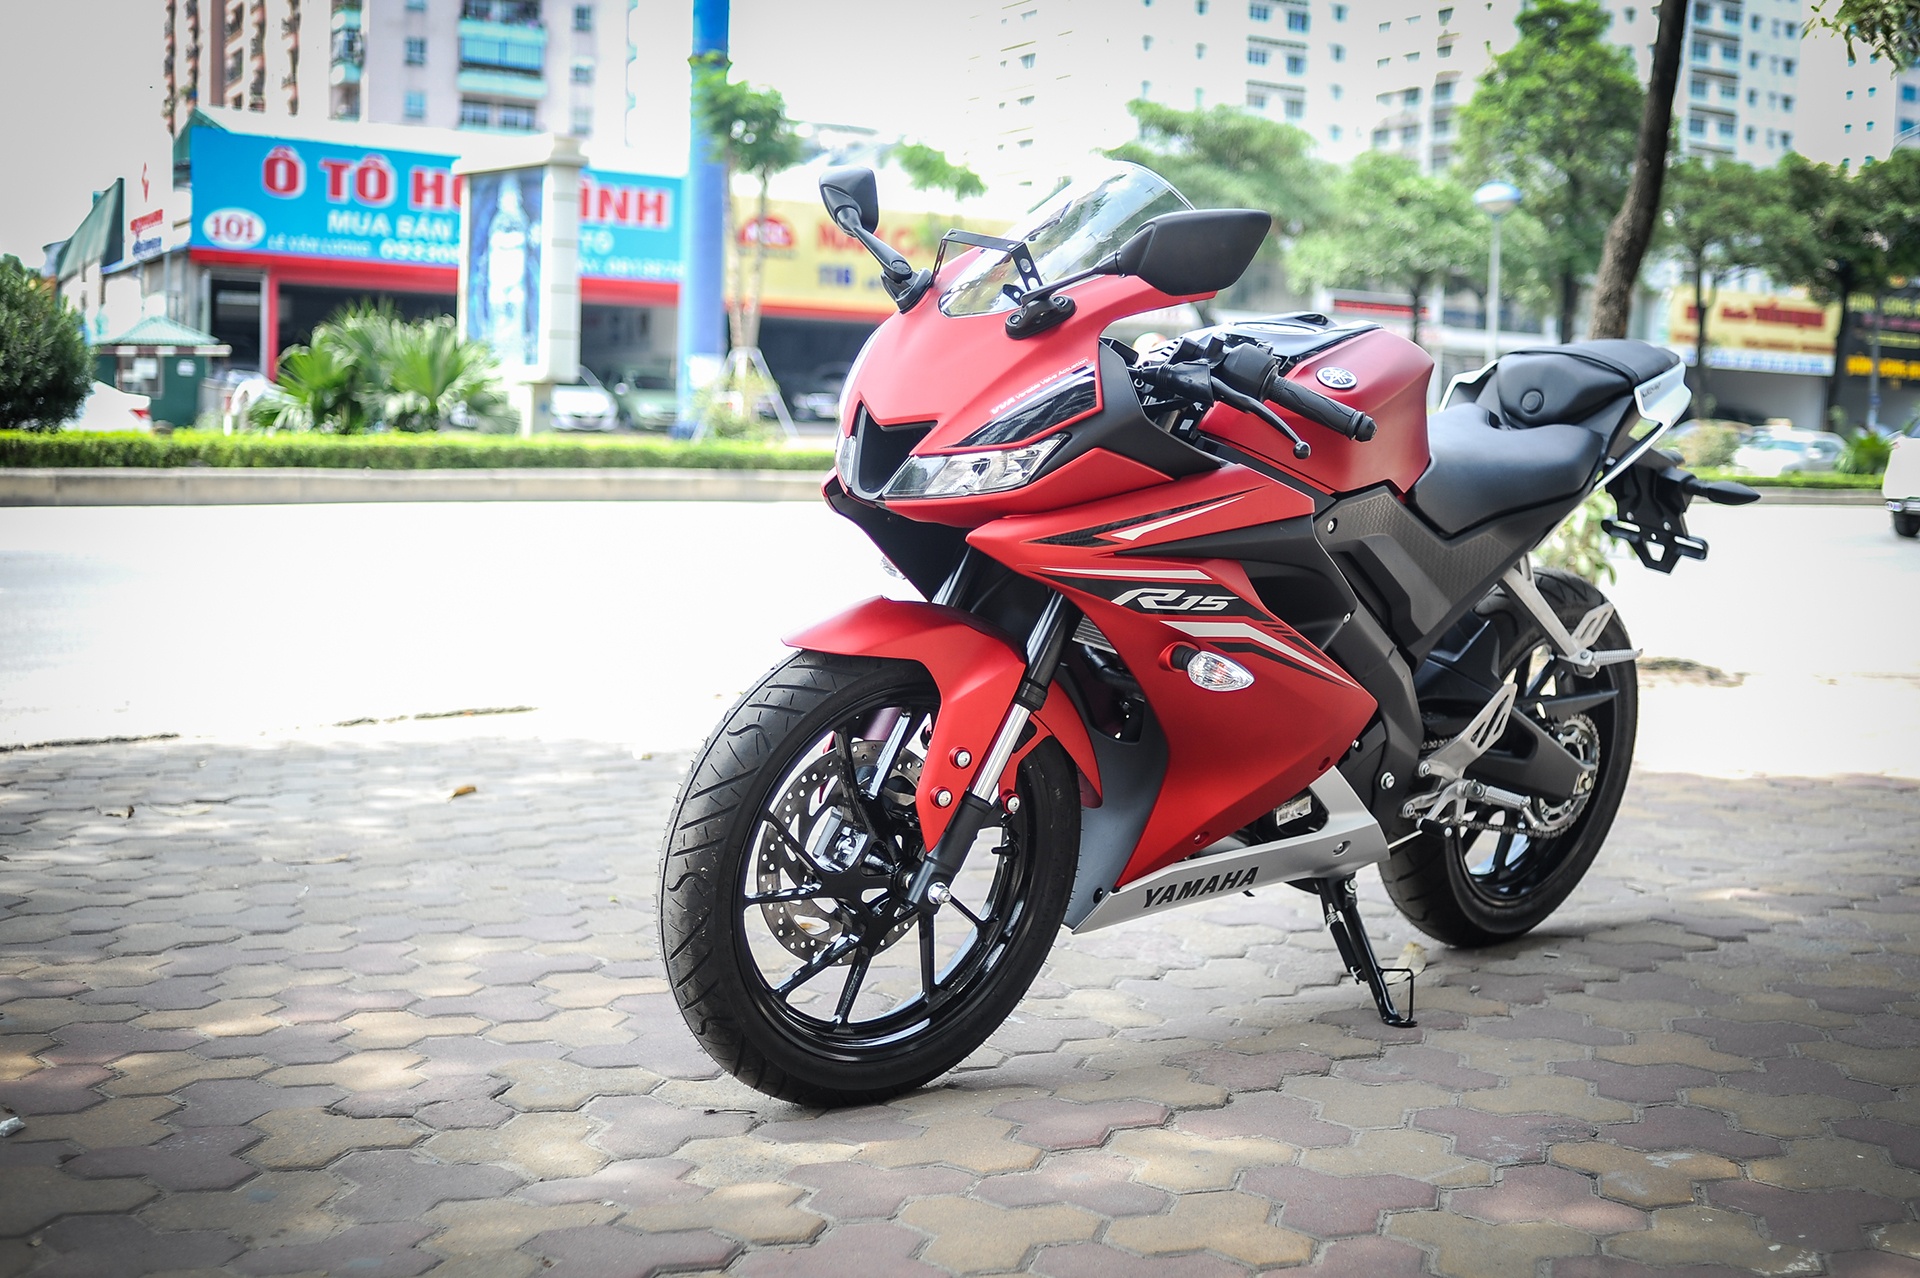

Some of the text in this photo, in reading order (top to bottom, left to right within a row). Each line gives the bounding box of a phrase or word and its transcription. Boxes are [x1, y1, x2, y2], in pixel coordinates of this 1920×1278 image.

[262, 145, 300, 196] Ô
[320, 154, 391, 202] TÔ
[210, 213, 257, 240] 101
[327, 210, 392, 237] MUA
[1015, 382, 1041, 399] Variable
[1040, 374, 1058, 385] Valve
[1058, 358, 1089, 376] Actuation
[1143, 866, 1260, 908] YAMAHA
